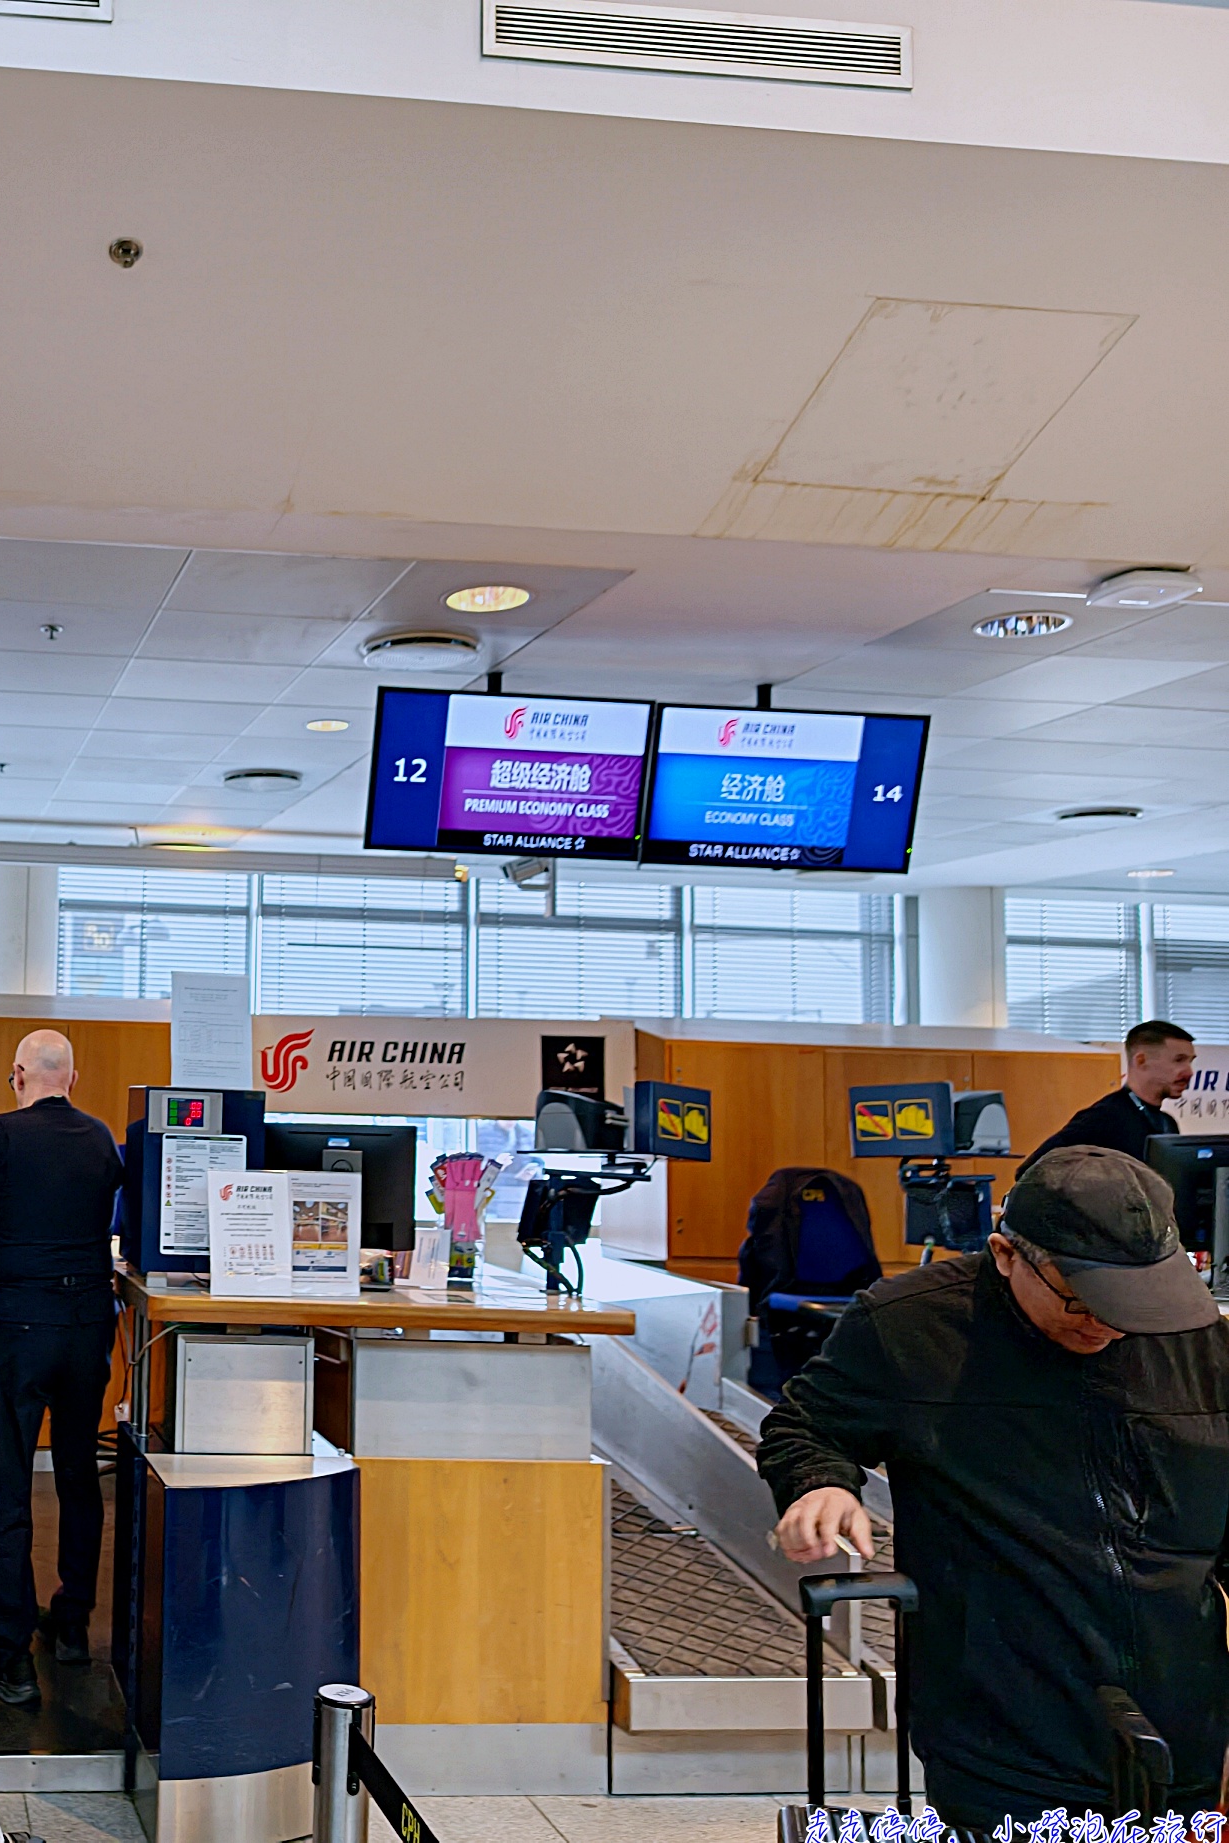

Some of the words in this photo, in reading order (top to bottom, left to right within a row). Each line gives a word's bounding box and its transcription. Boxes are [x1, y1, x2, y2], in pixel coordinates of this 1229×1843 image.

[530, 711, 552, 725] AIR
[553, 712, 590, 727] CHINA
[763, 723, 796, 737] CHINA
[393, 757, 428, 784] 12
[489, 758, 592, 793] 超级经济舱
[720, 772, 786, 803] 经济舱
[872, 784, 903, 803] 14
[464, 797, 518, 815] PREMIUM
[518, 799, 573, 817] ECONOMY
[573, 802, 610, 819] CLASS
[704, 810, 759, 826] ECONOMY
[759, 812, 795, 828] CLASS
[483, 833, 513, 848] STAR
[514, 835, 574, 850] ALLIANCE
[688, 843, 724, 859] STAR
[724, 845, 791, 862] ALLIANCE
[327, 1040, 375, 1063] AIR
[381, 1041, 466, 1065] CHINA
[1185, 1069, 1219, 1091] IR
[401, 1802, 420, 1843] CPH
